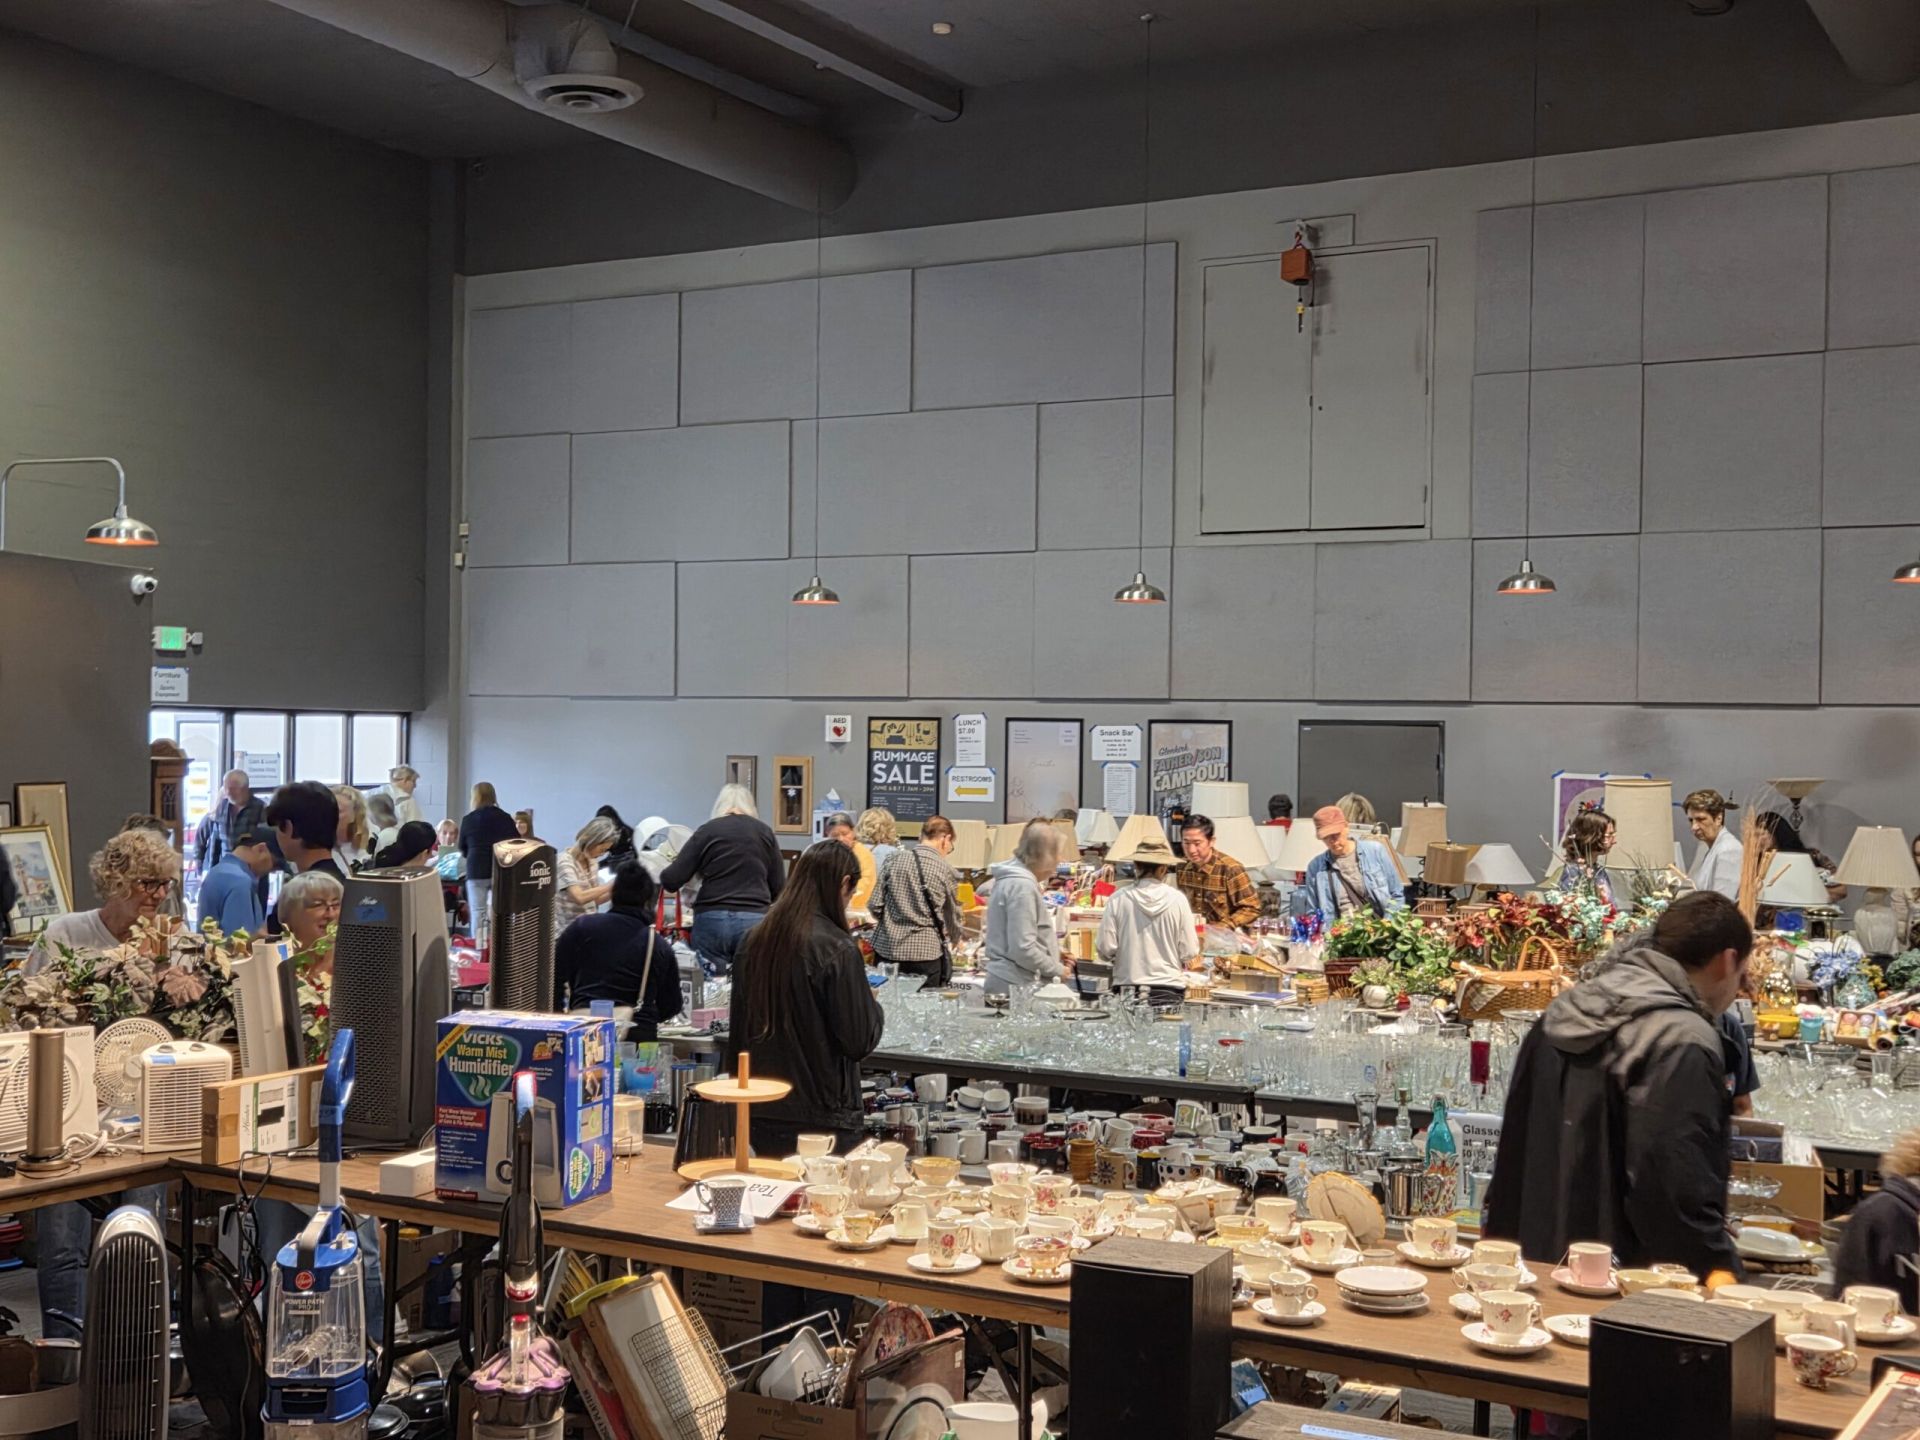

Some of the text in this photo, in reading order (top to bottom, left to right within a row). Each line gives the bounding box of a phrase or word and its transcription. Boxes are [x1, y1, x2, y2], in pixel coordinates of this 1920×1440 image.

[154, 670, 181, 679] Furniture
[958, 719, 982, 727] LUNCH
[958, 727, 976, 735] $7.00
[1100, 729, 1134, 737] Snack Bar
[872, 750, 935, 763] RUMMAGE
[872, 763, 935, 785] SALE
[952, 775, 993, 783] RESTROOMS
[1153, 763, 1227, 792] CAMPOUT
[462, 1032, 504, 1046] VICKS
[456, 1044, 508, 1059] Warm Mist
[449, 1056, 514, 1077] Humidifier
[1462, 1124, 1501, 1136] Glasse
[748, 1183, 779, 1198] Tea
